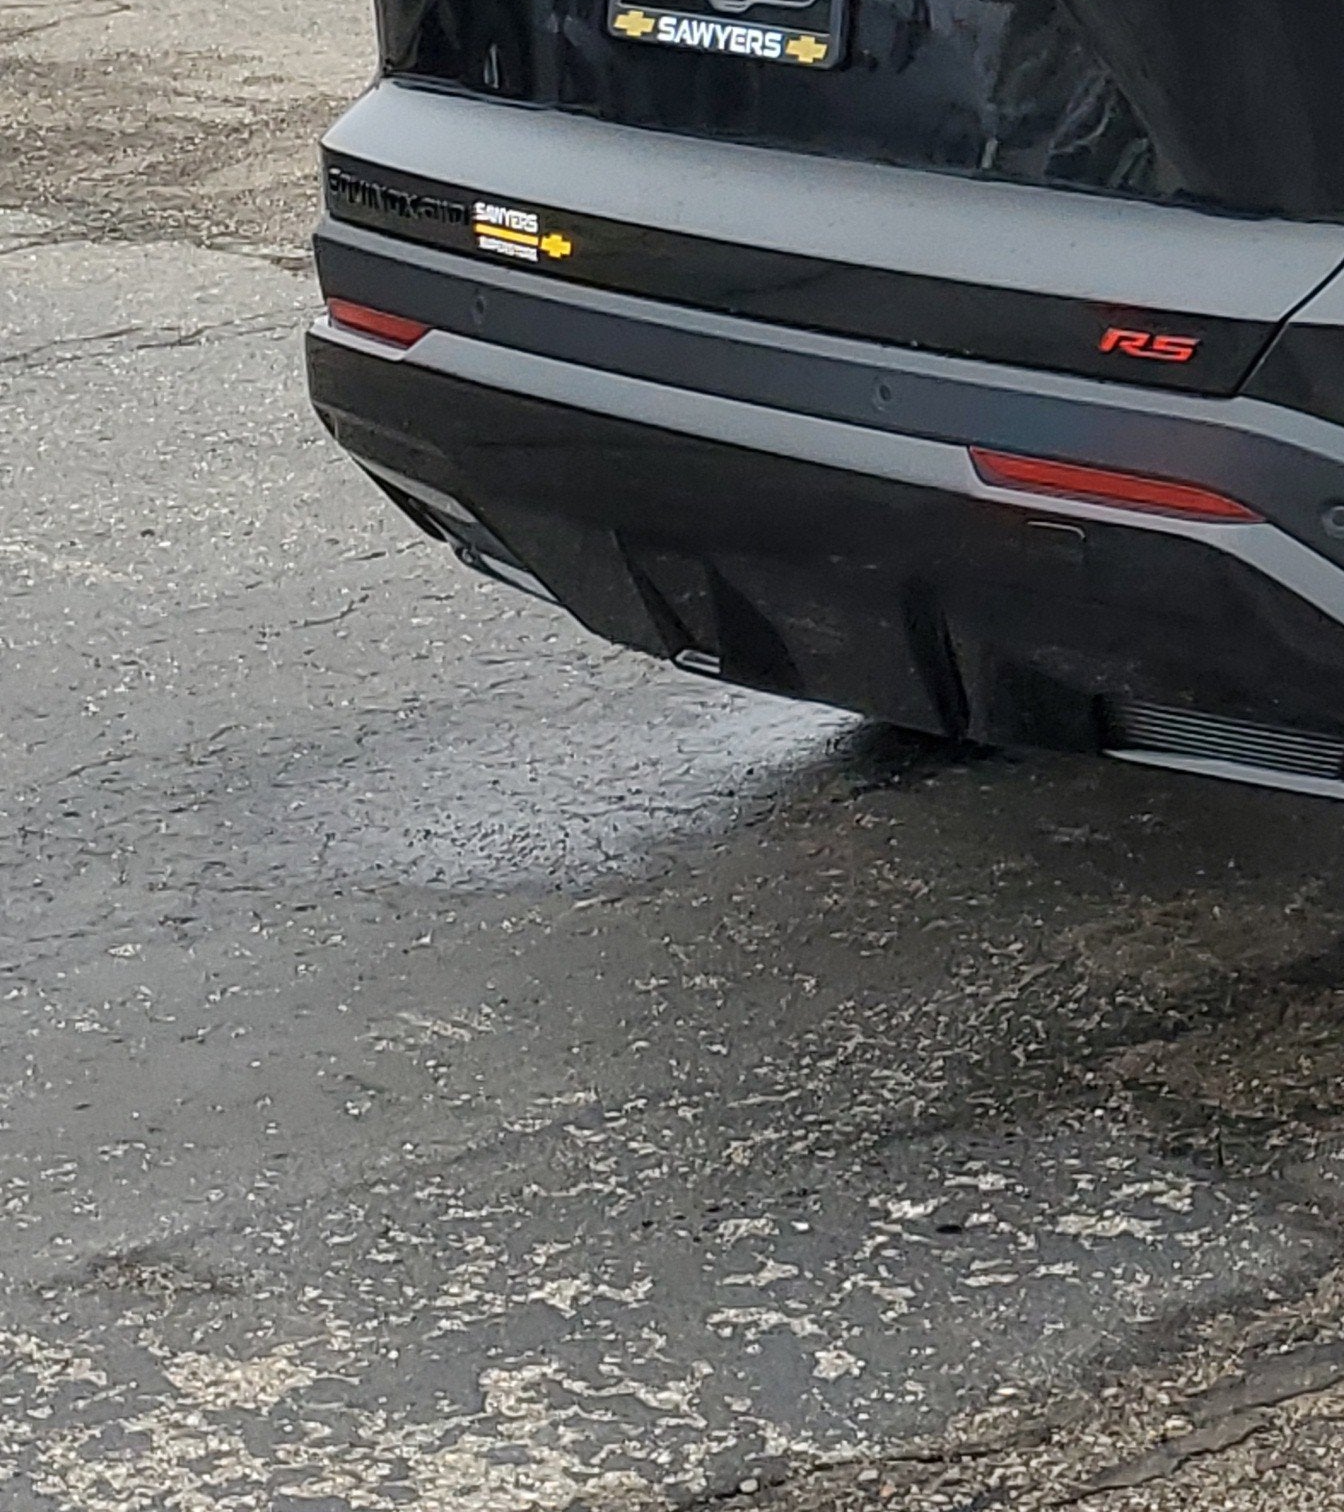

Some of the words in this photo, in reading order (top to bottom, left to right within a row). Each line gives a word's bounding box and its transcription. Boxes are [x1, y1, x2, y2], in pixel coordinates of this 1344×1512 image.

[656, 16, 783, 59] SAWYERS
[473, 201, 539, 233] SAWYERS
[1100, 326, 1200, 362] RS
